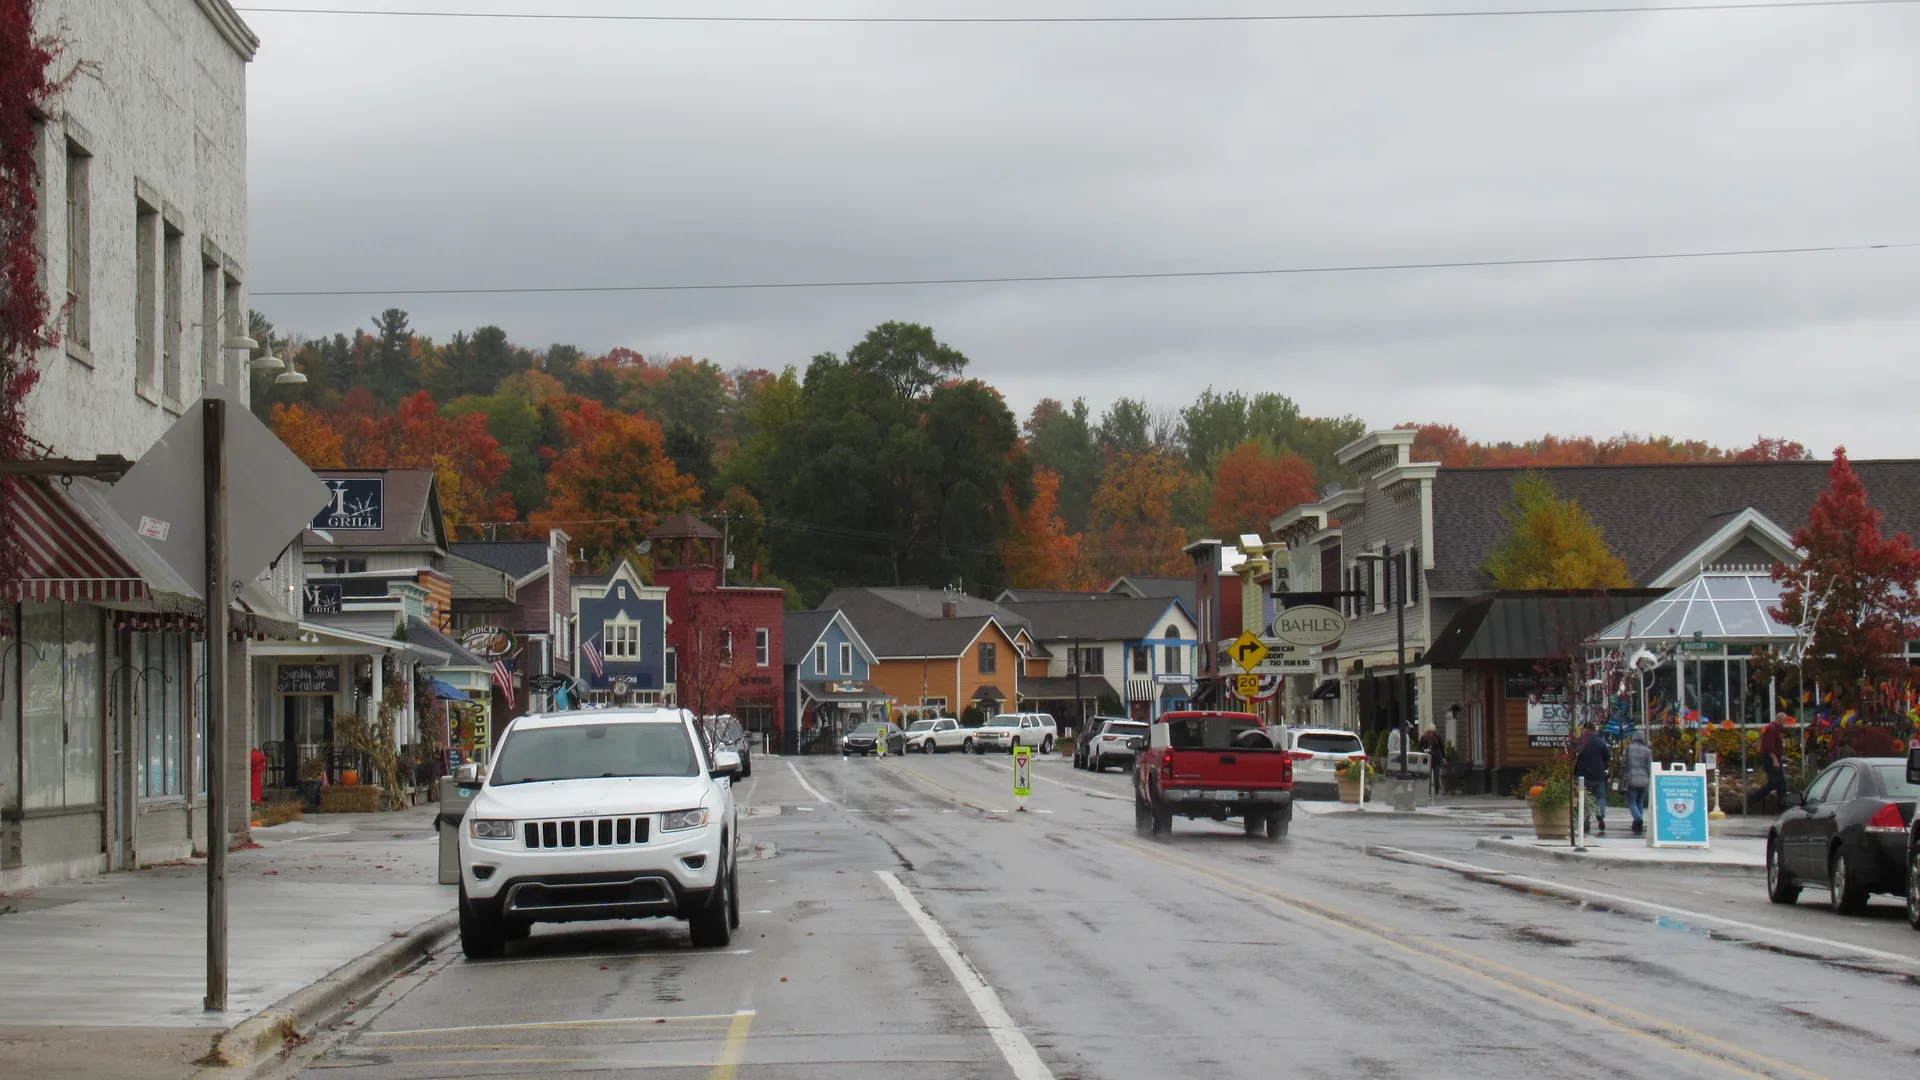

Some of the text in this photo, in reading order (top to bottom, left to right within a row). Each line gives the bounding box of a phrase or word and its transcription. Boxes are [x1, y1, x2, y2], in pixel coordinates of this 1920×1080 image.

[328, 517, 376, 527] GRILL
[1281, 618, 1340, 632] BAHLE'S
[461, 625, 499, 640] MURDICK'S
[280, 665, 336, 680] Sunday Steak
[292, 678, 327, 692] Feature
[1240, 677, 1257, 687] 20
[470, 704, 486, 744] OPEN
